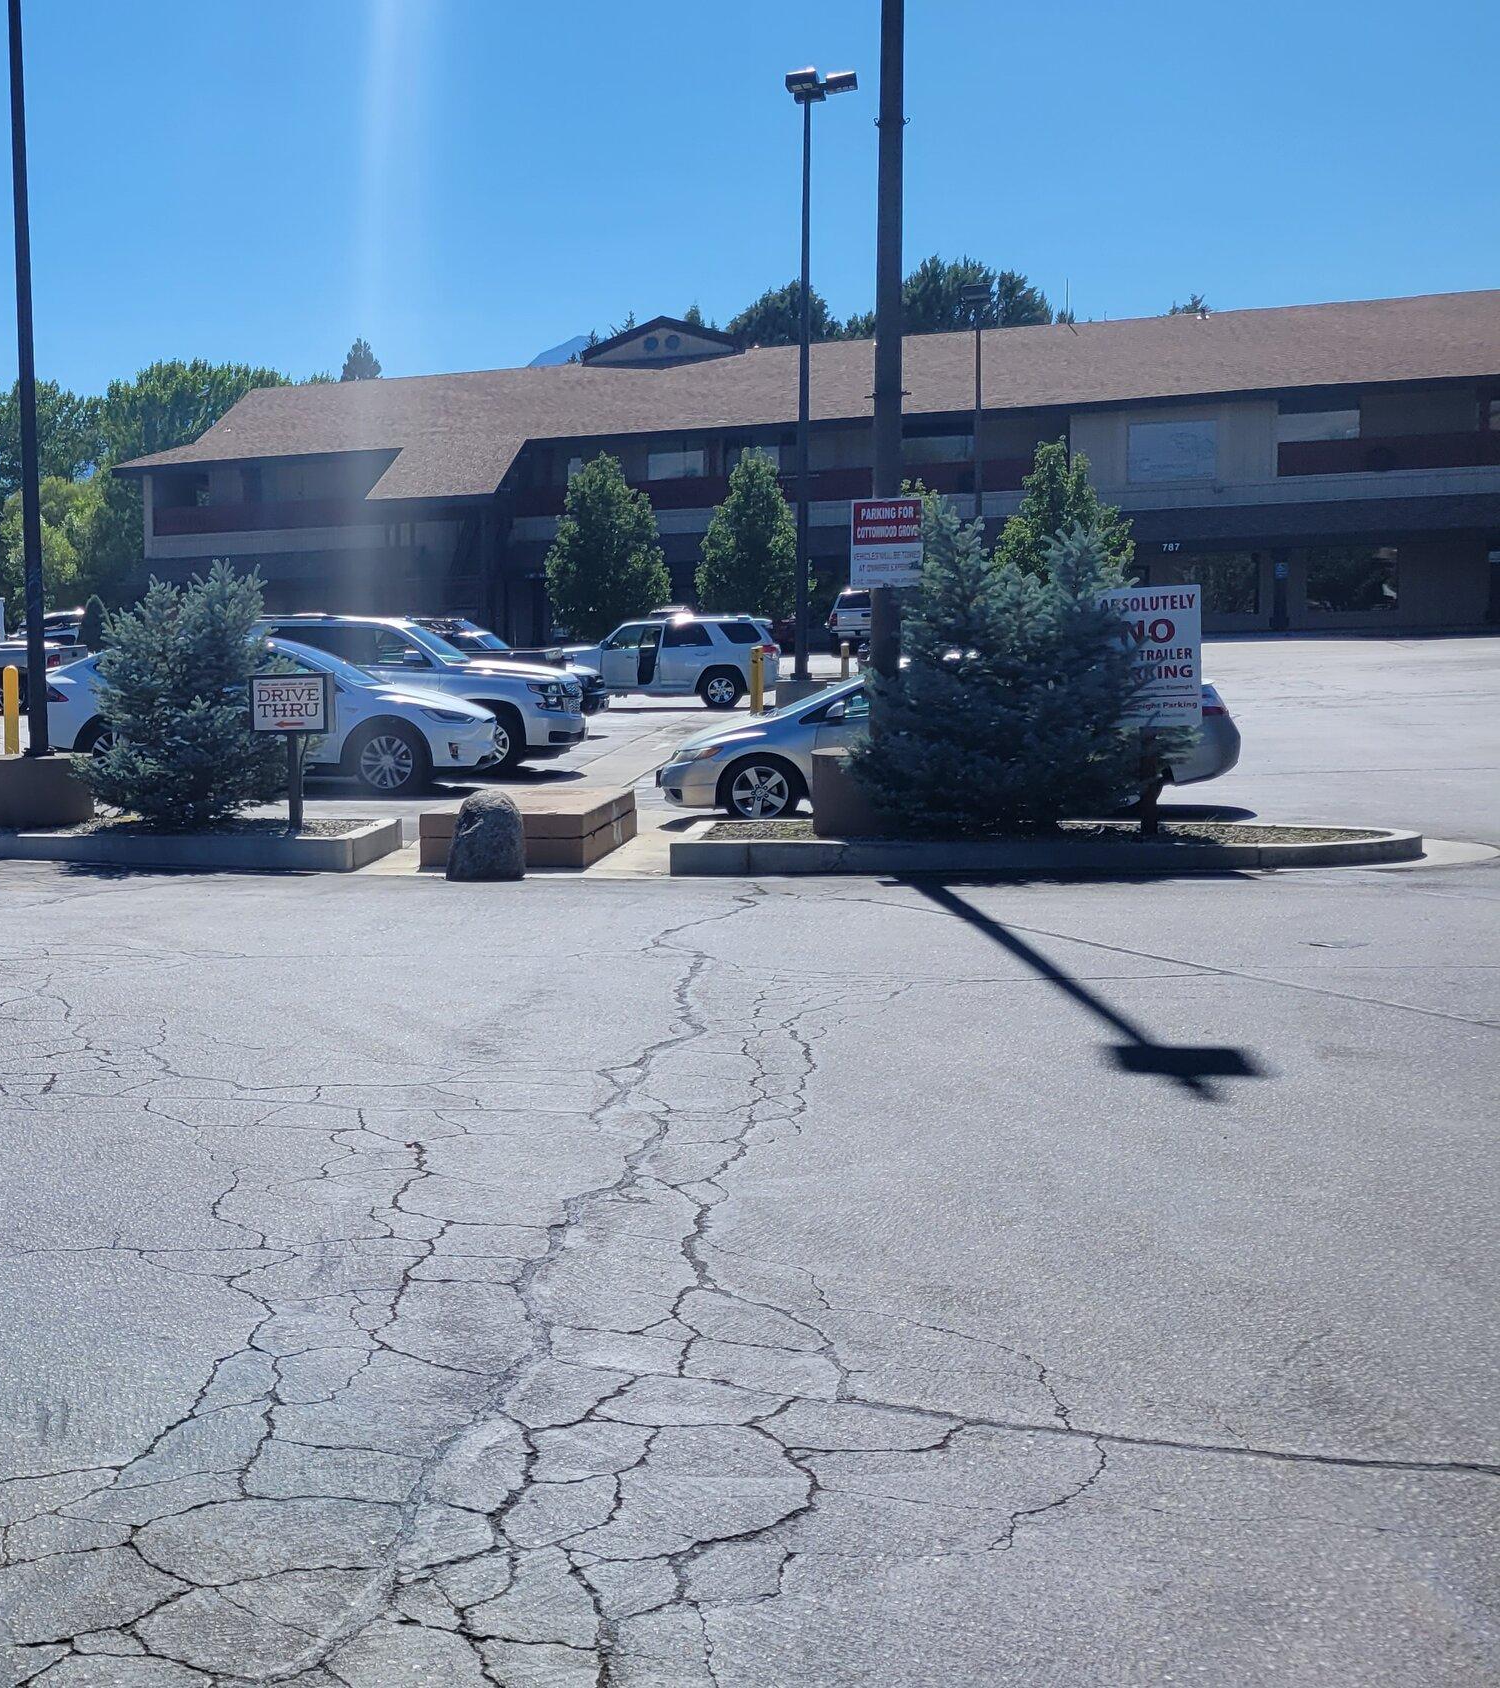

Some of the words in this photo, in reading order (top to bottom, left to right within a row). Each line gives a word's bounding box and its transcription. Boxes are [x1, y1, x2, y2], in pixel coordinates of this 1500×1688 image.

[861, 506, 897, 520] PARKING
[898, 505, 914, 519] FOR
[856, 525, 898, 539] COTTONWOOD
[1162, 542, 1181, 552] 787
[1120, 618, 1176, 645] NO
[1138, 647, 1193, 661] TRAILER
[257, 688, 320, 703] DRIVE
[257, 702, 320, 718] THRU
[1162, 701, 1198, 710] Parking
